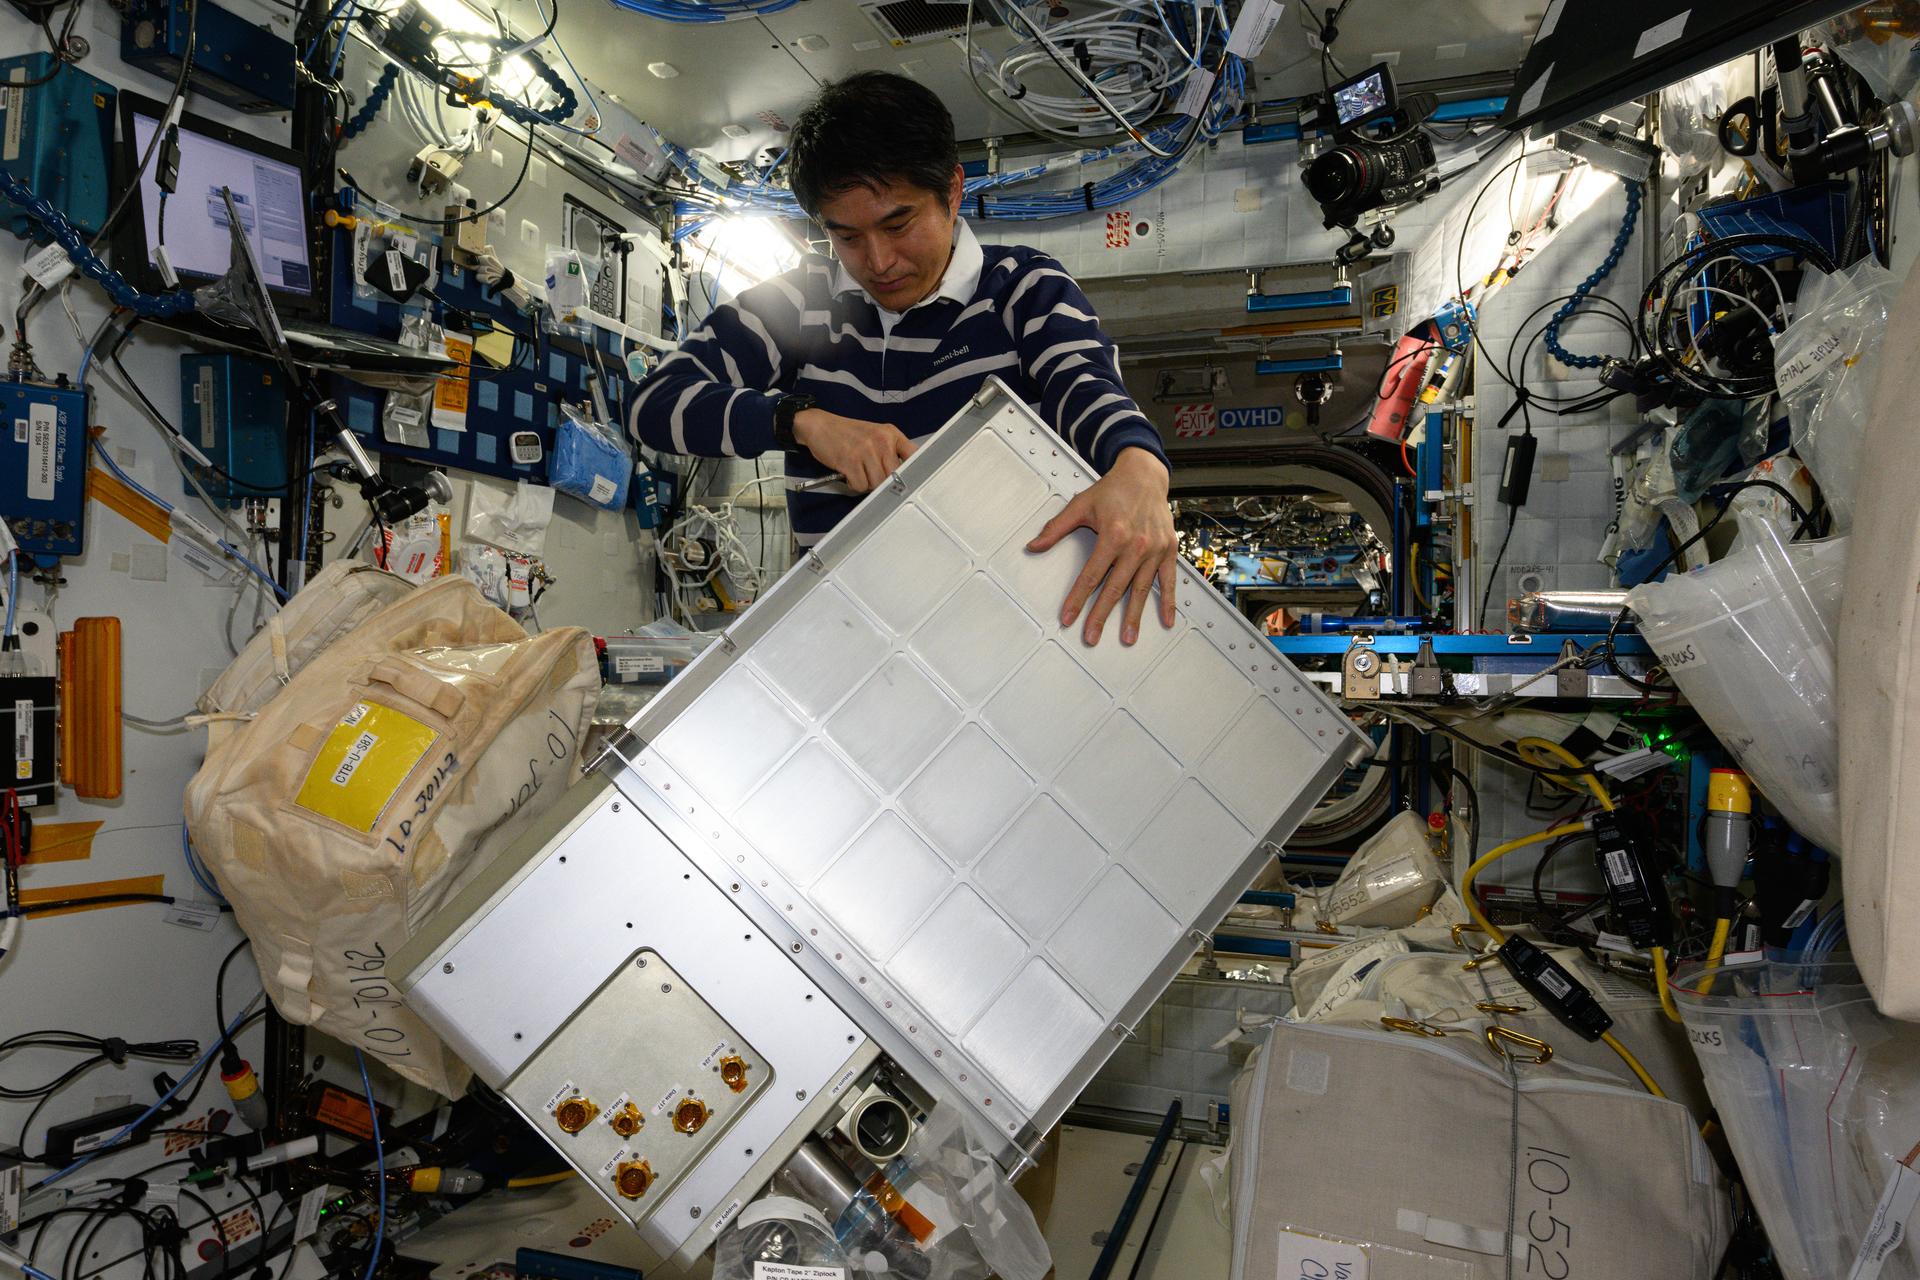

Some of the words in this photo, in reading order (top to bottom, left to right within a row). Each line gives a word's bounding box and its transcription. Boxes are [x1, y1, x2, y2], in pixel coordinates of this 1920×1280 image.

[1182, 413, 1208, 429] EXIT
[1221, 410, 1281, 427] OVHD
[708, 1041, 726, 1058] Power
[838, 1070, 854, 1087] Return
[556, 1083, 572, 1099] Power
[664, 1088, 677, 1101] Data
[831, 1086, 840, 1094] Air
[611, 1097, 625, 1110] Data
[612, 1149, 626, 1163] Data
[721, 1202, 738, 1220] Supply
[714, 1219, 723, 1228] Air
